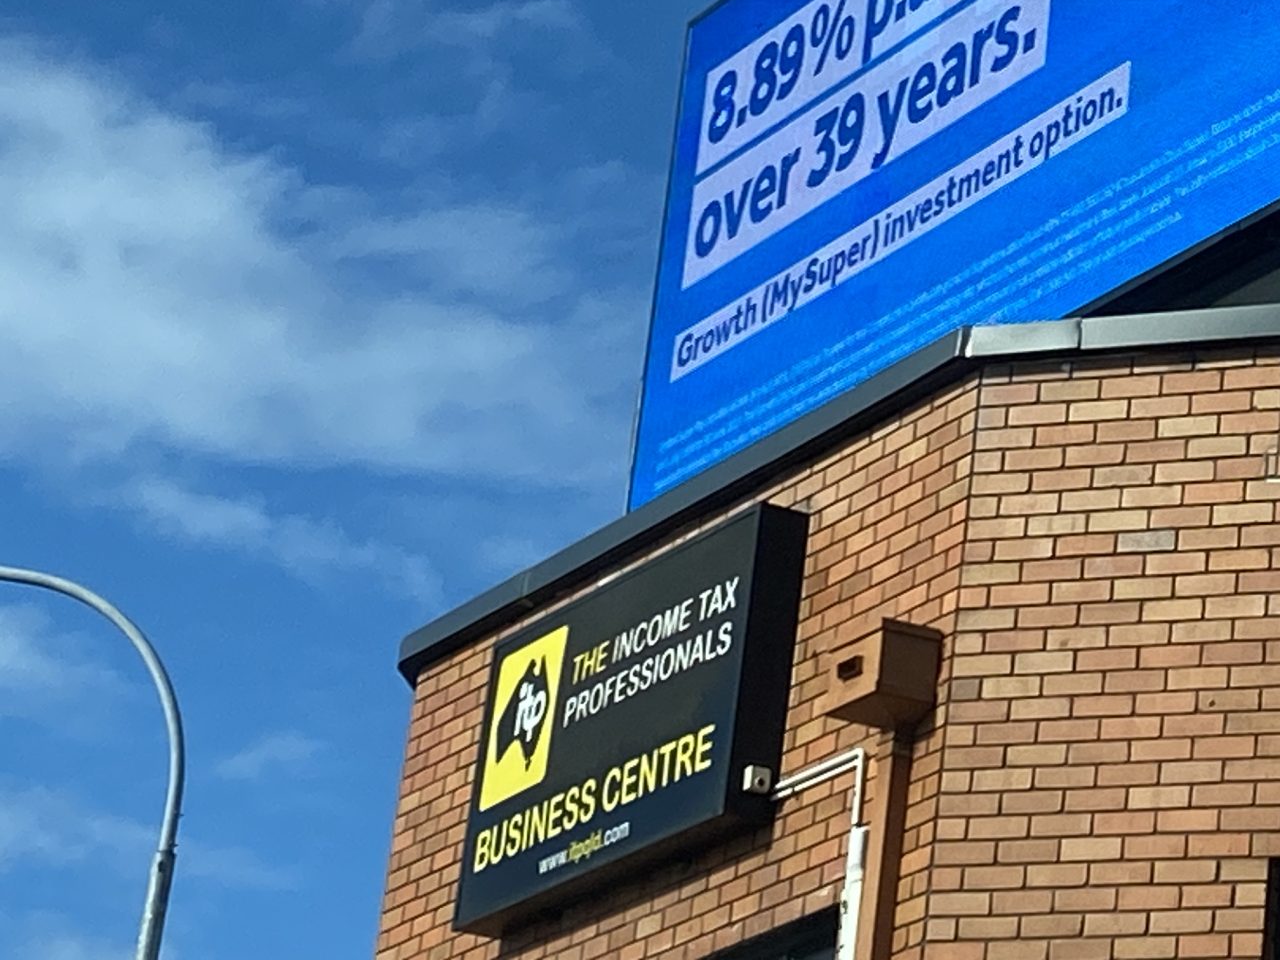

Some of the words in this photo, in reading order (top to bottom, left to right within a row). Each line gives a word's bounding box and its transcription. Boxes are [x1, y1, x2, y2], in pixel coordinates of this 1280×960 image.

[695, 147, 801, 259] over
[807, 93, 868, 189] 39
[871, 5, 1037, 169] years.
[677, 295, 759, 367] Growth
[761, 230, 879, 317] (MySuper)
[883, 139, 1024, 248] investment
[1029, 86, 1124, 163] option.
[563, 621, 733, 728] PROFESSIONALS
[573, 640, 610, 684] THE
[612, 597, 694, 666] INCOME
[698, 577, 740, 622] TAX
[513, 681, 547, 742] itp
[473, 778, 597, 874] BUSINESS
[602, 724, 716, 813] CENTRE
